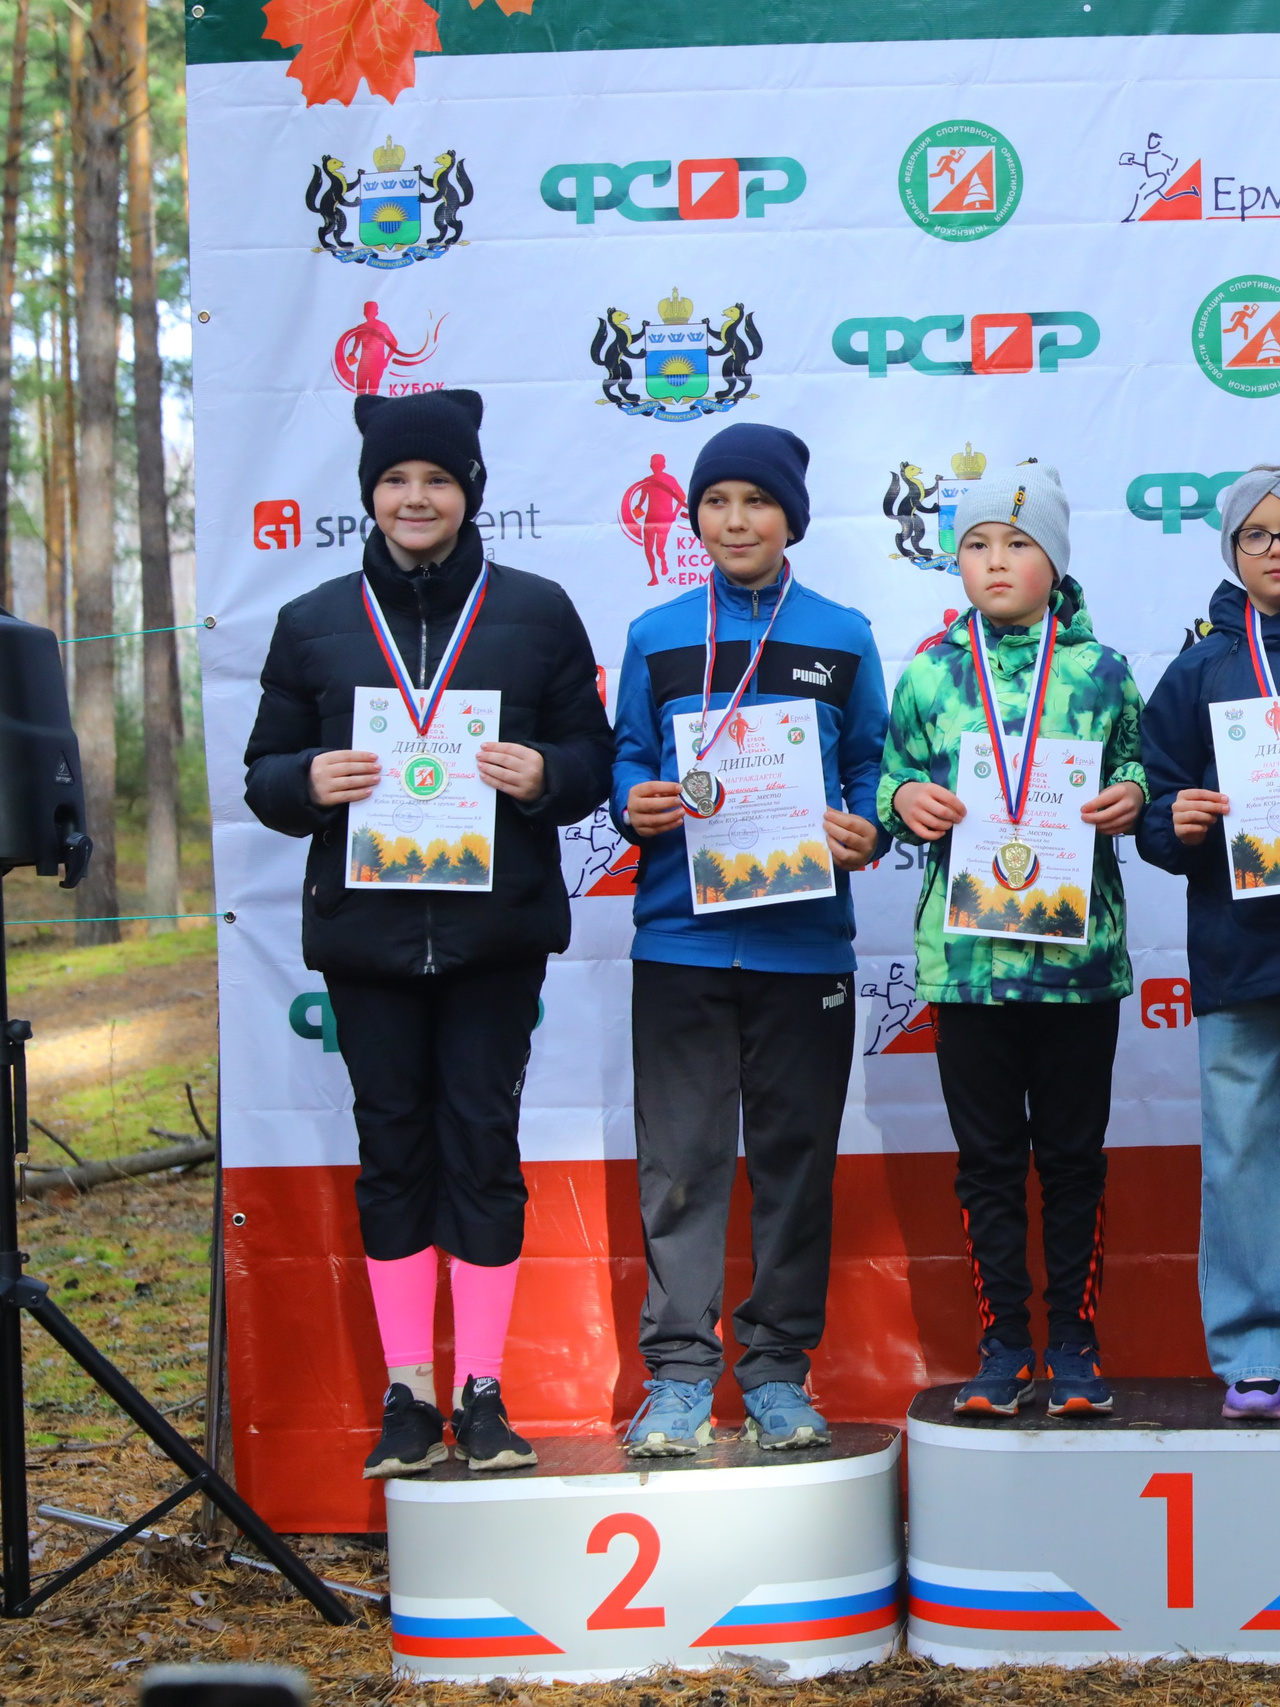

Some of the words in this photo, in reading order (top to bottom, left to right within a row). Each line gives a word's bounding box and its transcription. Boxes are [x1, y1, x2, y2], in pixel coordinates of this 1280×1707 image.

[935, 125, 997, 143] СПОРТИВНОГО
[904, 136, 932, 183] ФЕДЕРАЦИЯ
[993, 146, 1018, 223] ОРИЕНТИРОВАНИЯ
[904, 188, 930, 224] ОБЛАСТИ
[934, 224, 989, 237] ТЮМЕНСКОЙ
[1198, 292, 1225, 339] ФЕДЕРАЦИЯ
[1199, 344, 1223, 379] ОБЛАСТИ
[389, 381, 445, 396] КУБОК
[677, 554, 713, 568] КСО
[792, 668, 827, 687] PUMA
[392, 741, 463, 754] ДИПЛОМ
[717, 752, 785, 772] ДИПЛОМ
[725, 772, 783, 784] НАГРАЖДАЕТСЯ
[756, 793, 782, 801] место
[822, 992, 845, 1010] PUMA
[1141, 1473, 1194, 1609] 1
[587, 1514, 664, 1631] 2
